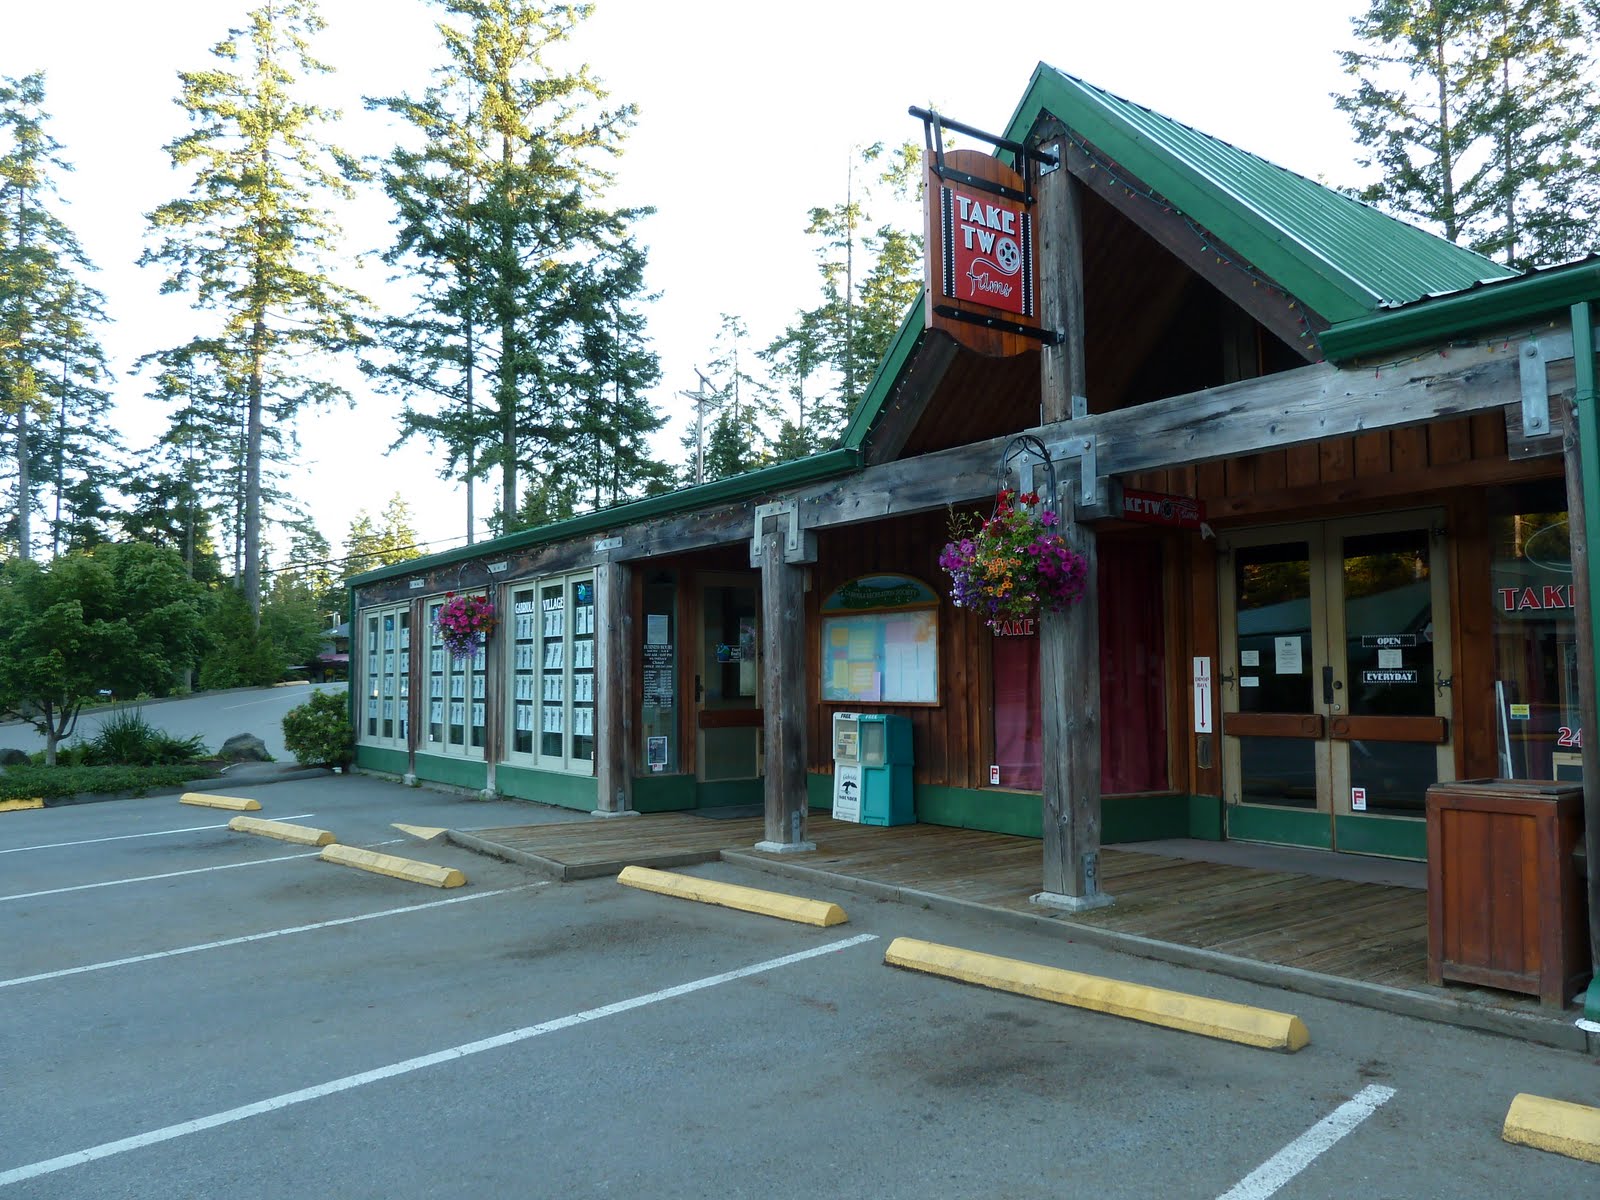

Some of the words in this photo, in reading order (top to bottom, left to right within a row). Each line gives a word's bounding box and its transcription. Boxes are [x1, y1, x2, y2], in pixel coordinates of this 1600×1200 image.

[956, 195, 1015, 235] TAKE
[1376, 637, 1401, 645] OPEN
[1366, 673, 1413, 681] EVERYDAY
